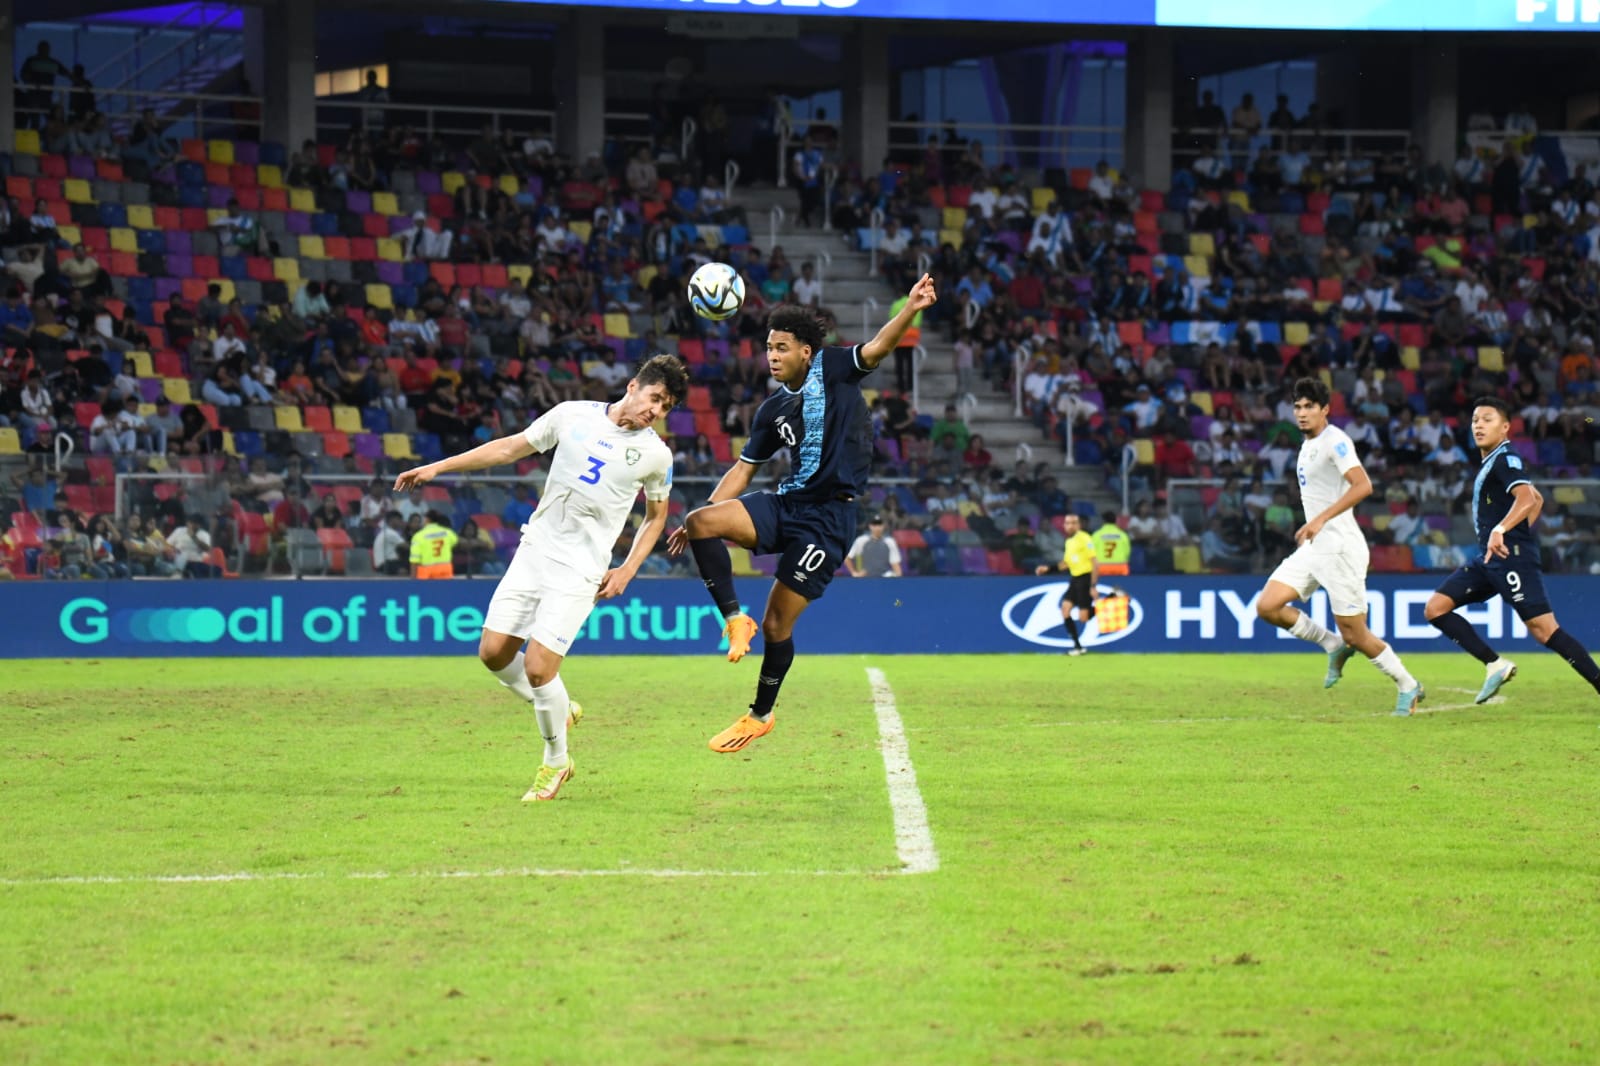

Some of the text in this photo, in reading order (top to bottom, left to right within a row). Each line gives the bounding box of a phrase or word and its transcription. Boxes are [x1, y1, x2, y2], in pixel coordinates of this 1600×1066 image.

[578, 455, 606, 485] 3
[797, 543, 826, 572] 10
[1506, 571, 1522, 592] 9
[302, 595, 367, 643] of
[380, 595, 484, 642] the
